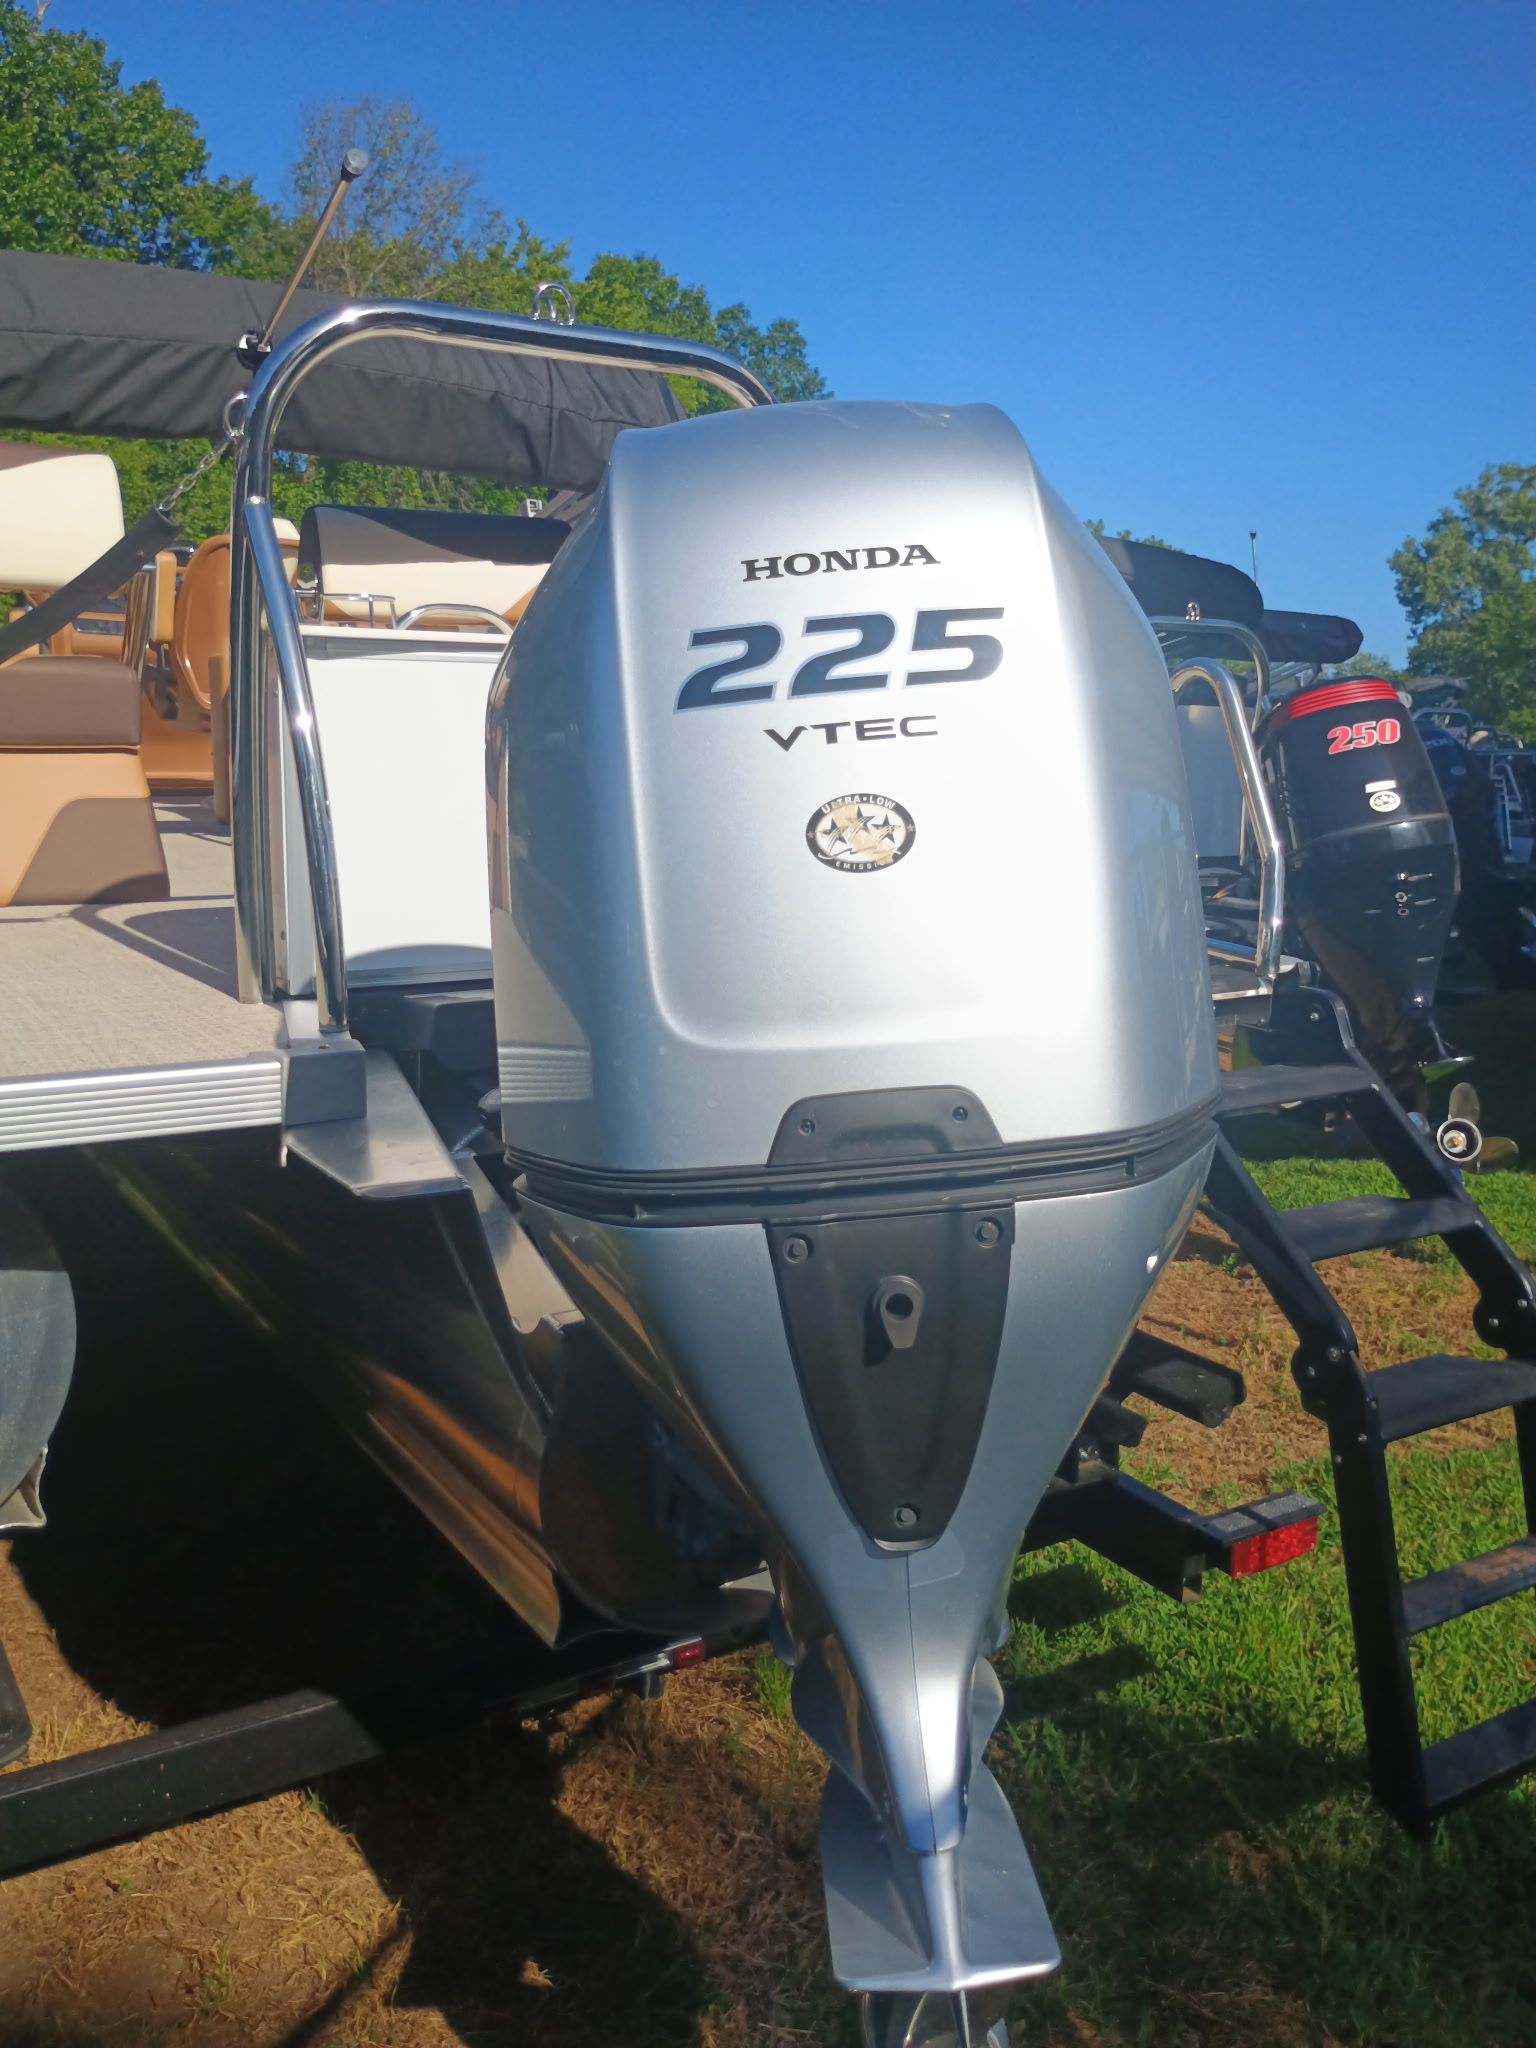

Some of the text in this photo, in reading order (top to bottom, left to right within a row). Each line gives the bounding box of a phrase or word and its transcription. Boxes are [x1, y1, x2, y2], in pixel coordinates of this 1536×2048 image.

[740, 544, 941, 582] HONDA
[673, 607, 1004, 714] 225
[763, 715, 938, 752] VTEC
[1327, 718, 1400, 755] 250
[835, 859, 889, 871] EMISSI
